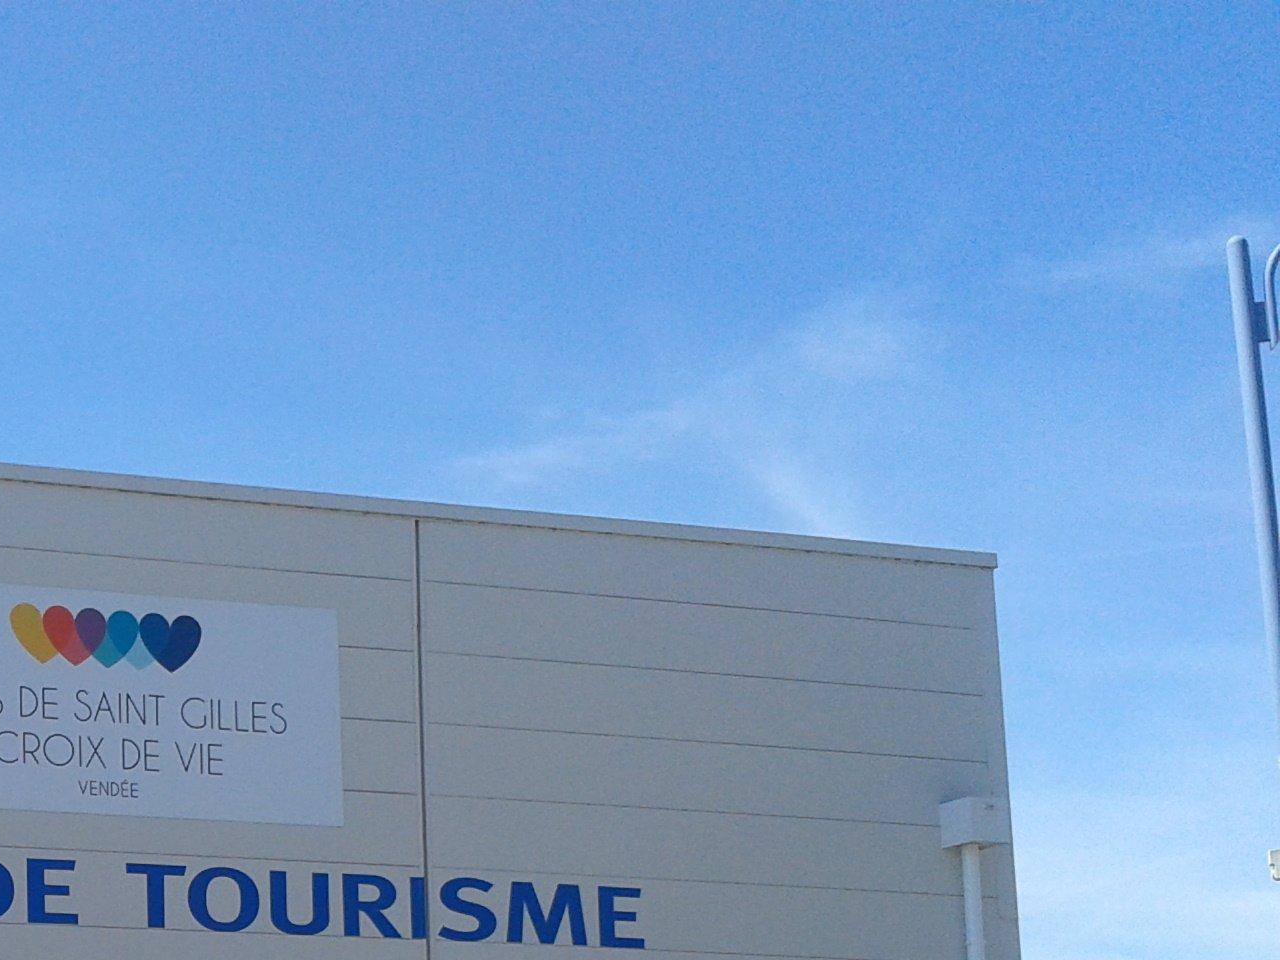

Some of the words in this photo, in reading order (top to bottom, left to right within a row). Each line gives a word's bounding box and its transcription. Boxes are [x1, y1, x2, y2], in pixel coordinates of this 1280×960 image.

[19, 685, 59, 720] DE
[73, 689, 166, 727] SAINT
[180, 696, 288, 735] GILLES
[121, 738, 160, 772] DE
[174, 740, 224, 776] VIE
[78, 778, 140, 799] VENDÉE
[125, 862, 646, 949] TOURISME
